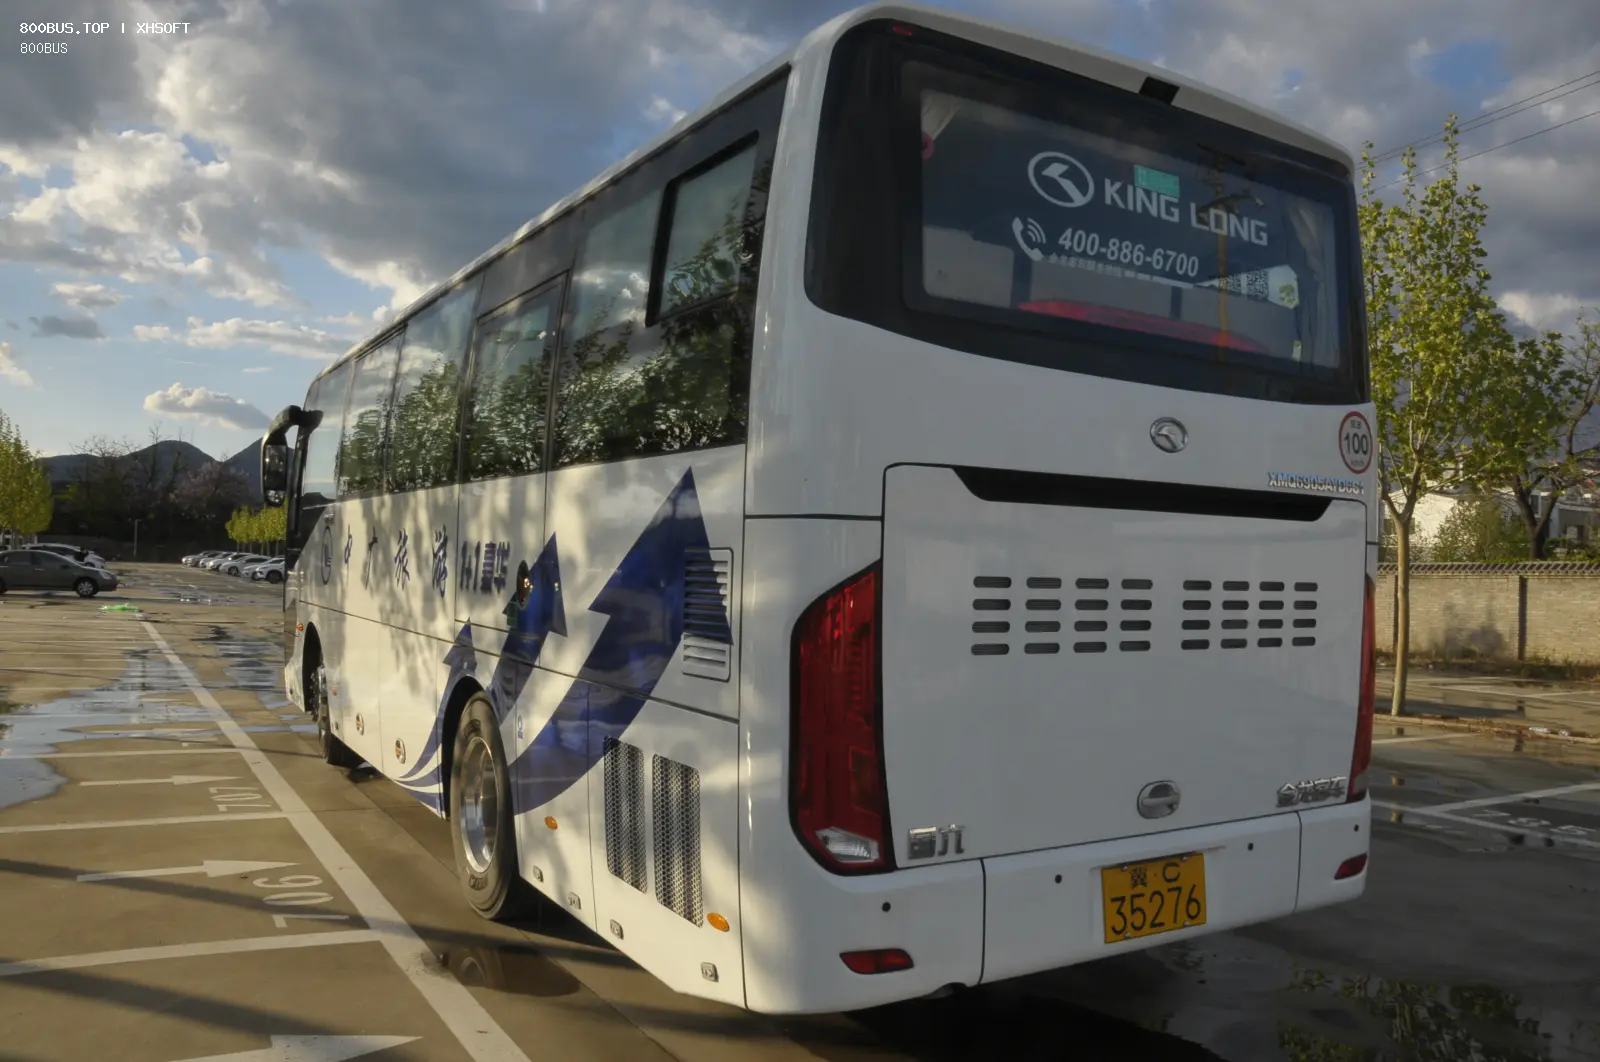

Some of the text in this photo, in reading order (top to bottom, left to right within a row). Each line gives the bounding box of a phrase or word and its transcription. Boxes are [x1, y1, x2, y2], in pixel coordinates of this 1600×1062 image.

[1104, 178, 1181, 224] KING
[1190, 202, 1269, 247] LONG
[1058, 227, 1200, 278] 400-886-6700
[1344, 431, 1369, 456] 100
[252, 874, 350, 928] 706
[1110, 884, 1202, 935] 35276
